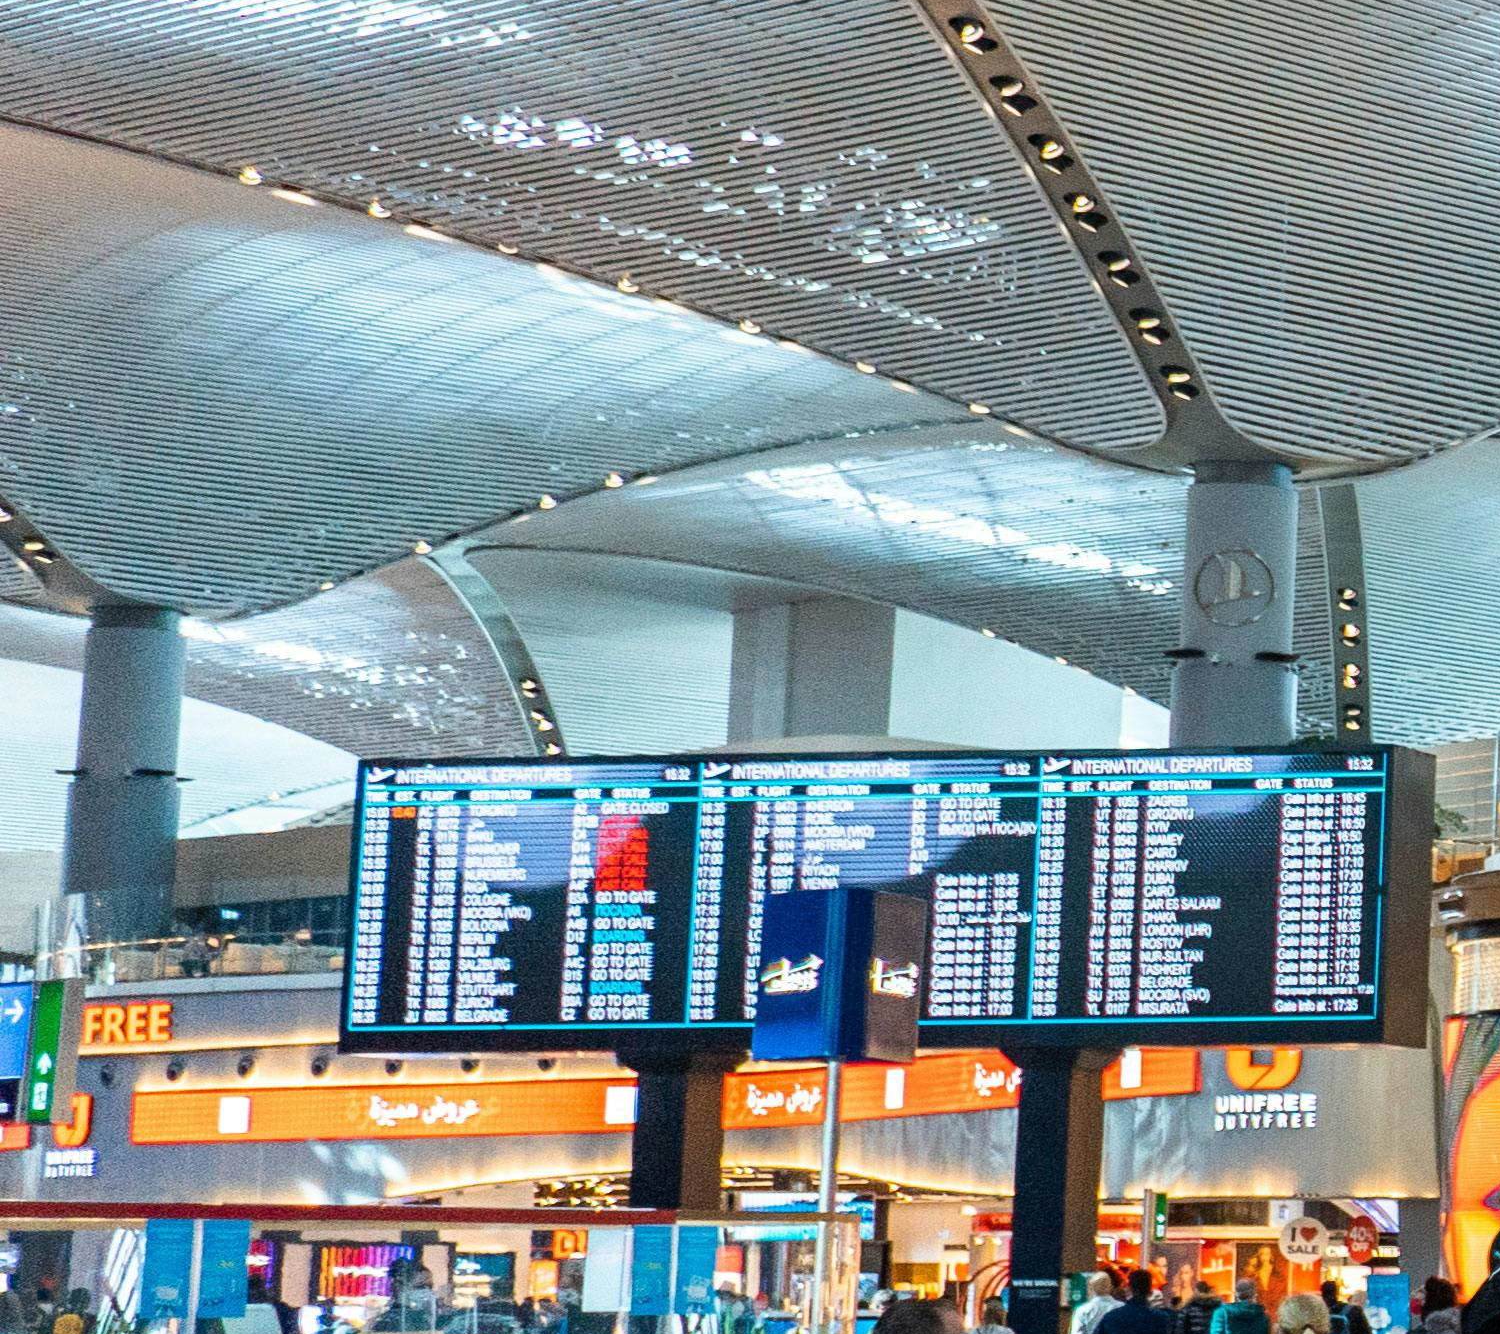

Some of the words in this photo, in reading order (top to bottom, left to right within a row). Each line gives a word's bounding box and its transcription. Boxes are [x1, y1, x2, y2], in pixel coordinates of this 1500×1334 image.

[733, 764, 826, 780] INTERNATIONAL
[828, 764, 911, 778] DEPARTURES
[1071, 759, 1168, 774] INTERNATIONAL
[1170, 757, 1253, 774] DEPARTURES
[1347, 758, 1374, 770] 15:32
[396, 769, 486, 784] INTERNATIONAL
[1294, 778, 1334, 788] STATUS
[81, 1000, 173, 1045] FREE
[1215, 1093, 1318, 1113] UNIFREE
[1214, 1113, 1317, 1131] DUTYFREE
[1287, 1244, 1320, 1255] SALE
